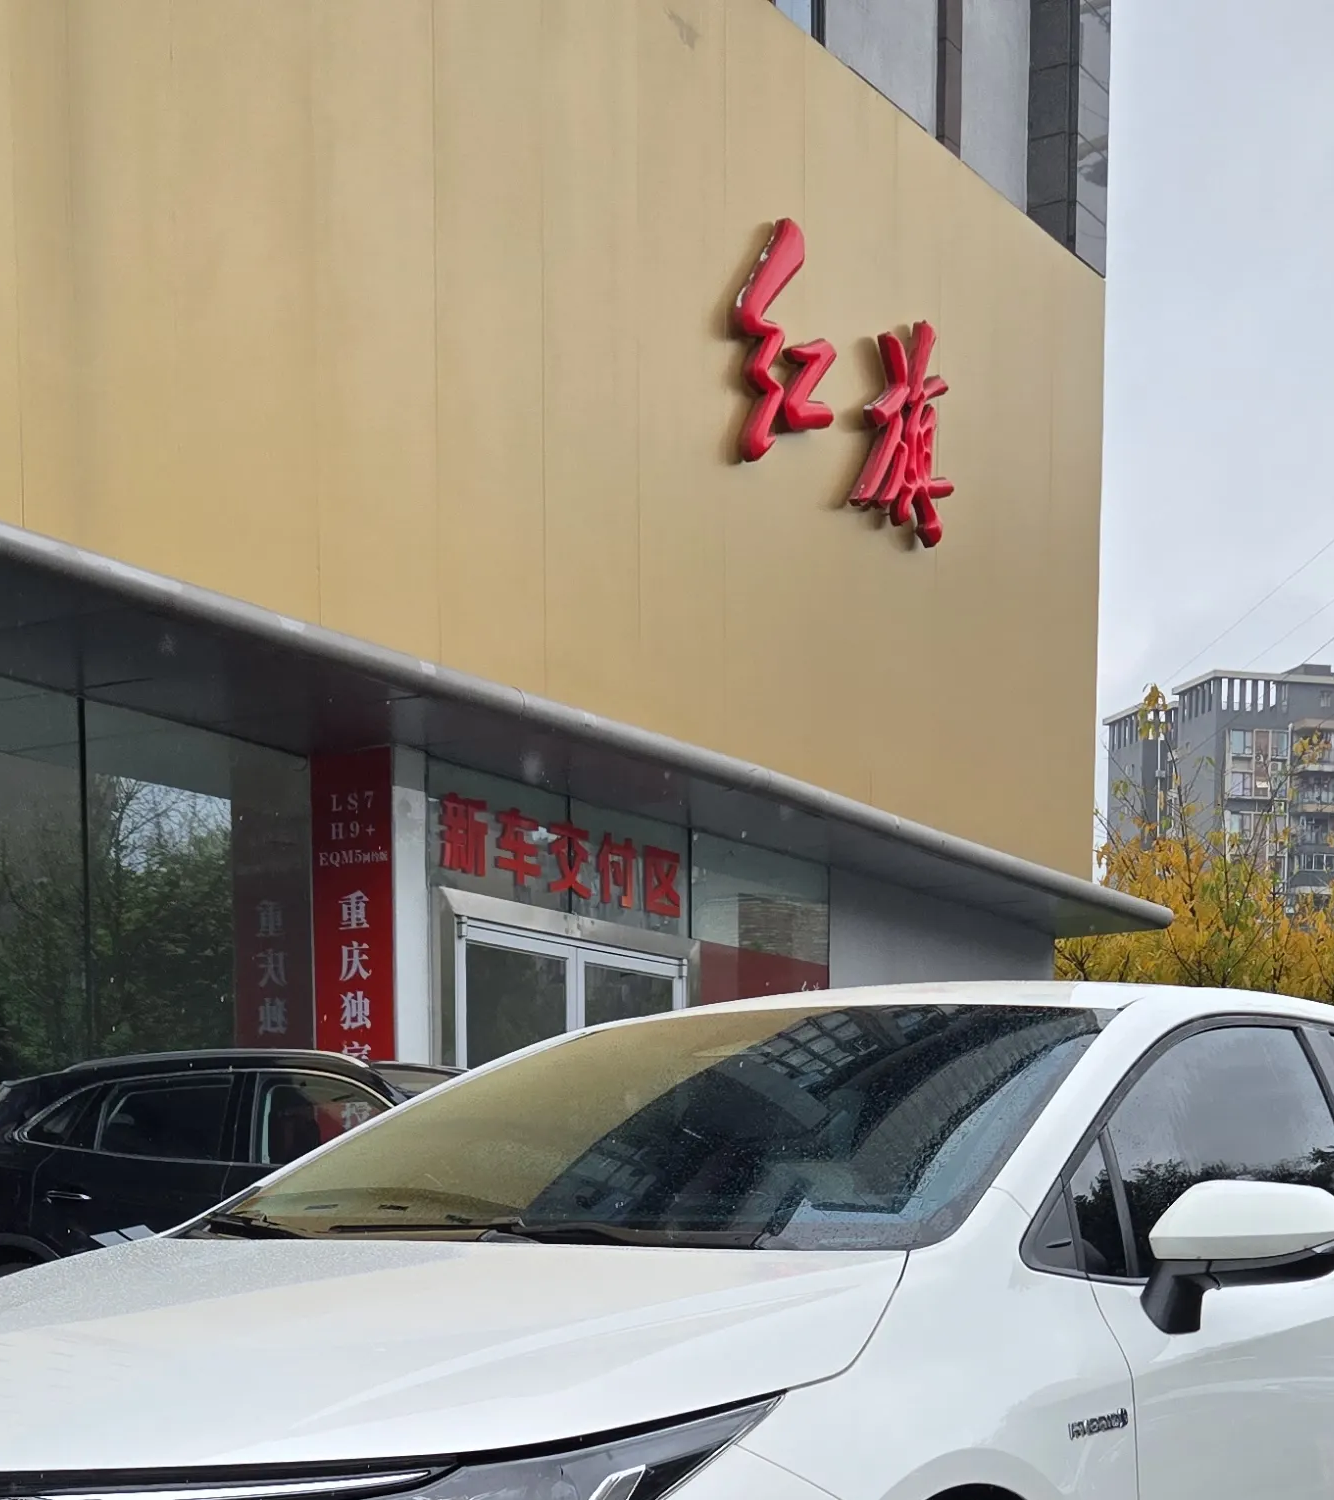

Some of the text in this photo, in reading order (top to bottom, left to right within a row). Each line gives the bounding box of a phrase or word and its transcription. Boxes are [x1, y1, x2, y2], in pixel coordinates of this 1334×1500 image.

[731, 217, 955, 548] 红旗
[330, 791, 374, 812] LS7
[331, 821, 376, 840] H9+
[439, 792, 681, 918] 新车交付区
